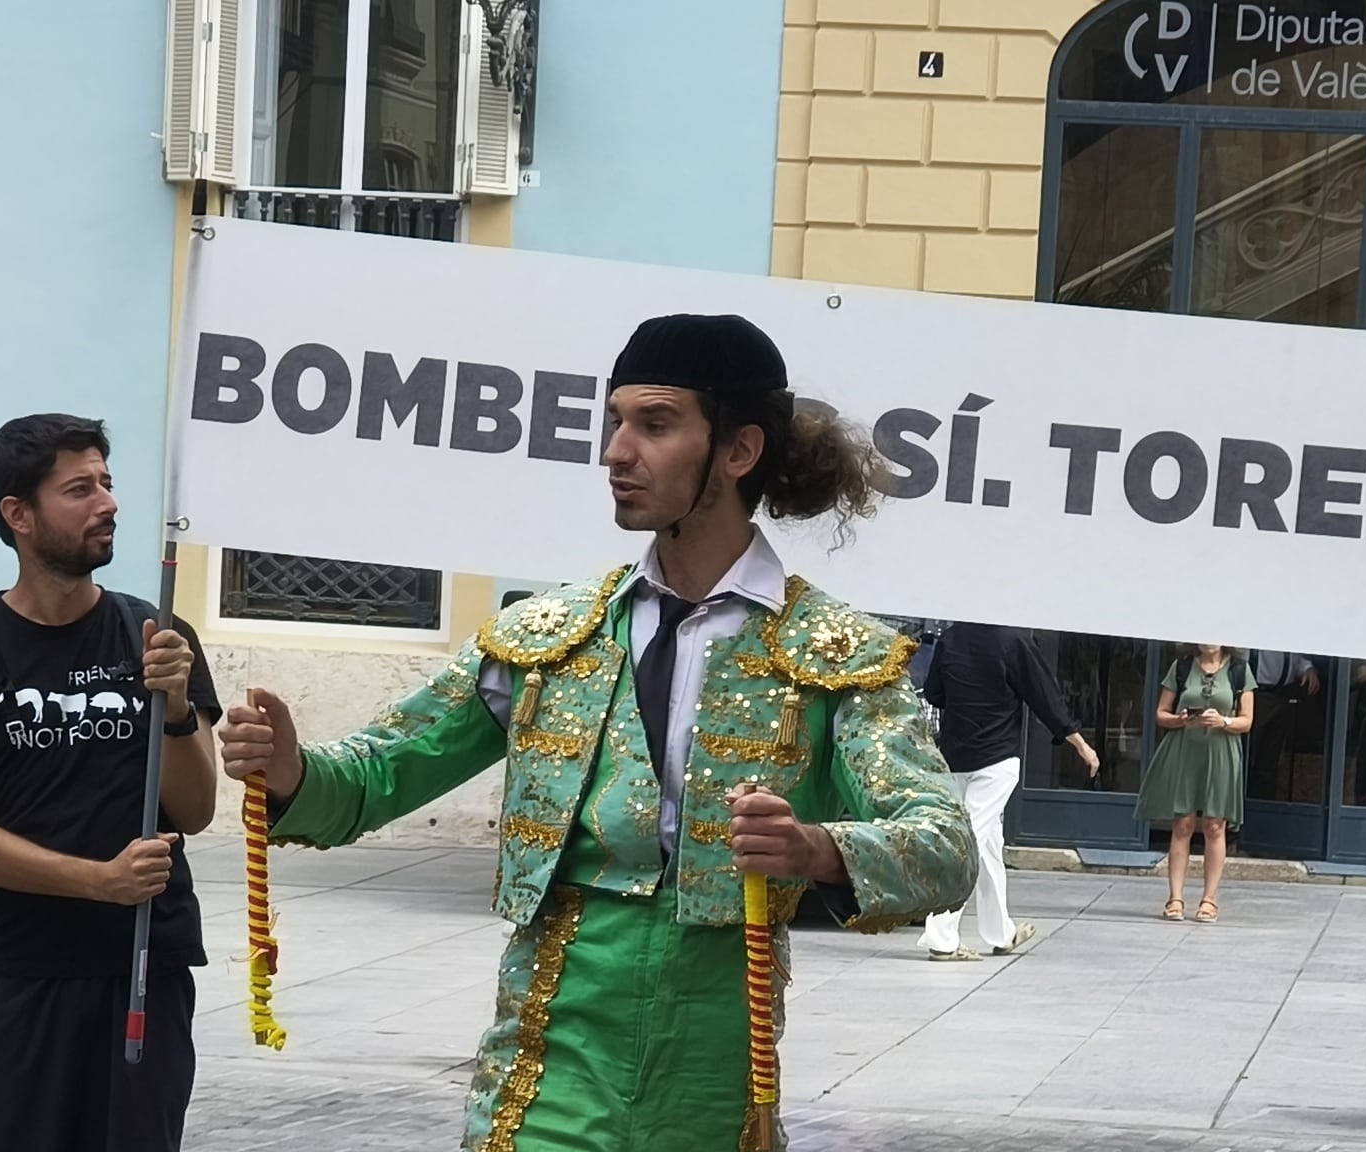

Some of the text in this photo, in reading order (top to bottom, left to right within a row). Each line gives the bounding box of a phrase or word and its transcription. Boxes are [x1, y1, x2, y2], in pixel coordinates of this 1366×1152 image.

[922, 52, 936, 76] 4
[1231, 58, 1281, 97] de
[191, 332, 839, 467] BOMBE
[872, 392, 1011, 507] SÍ.
[69, 665, 134, 685] FRIEN
[69, 719, 133, 746] FOOD
